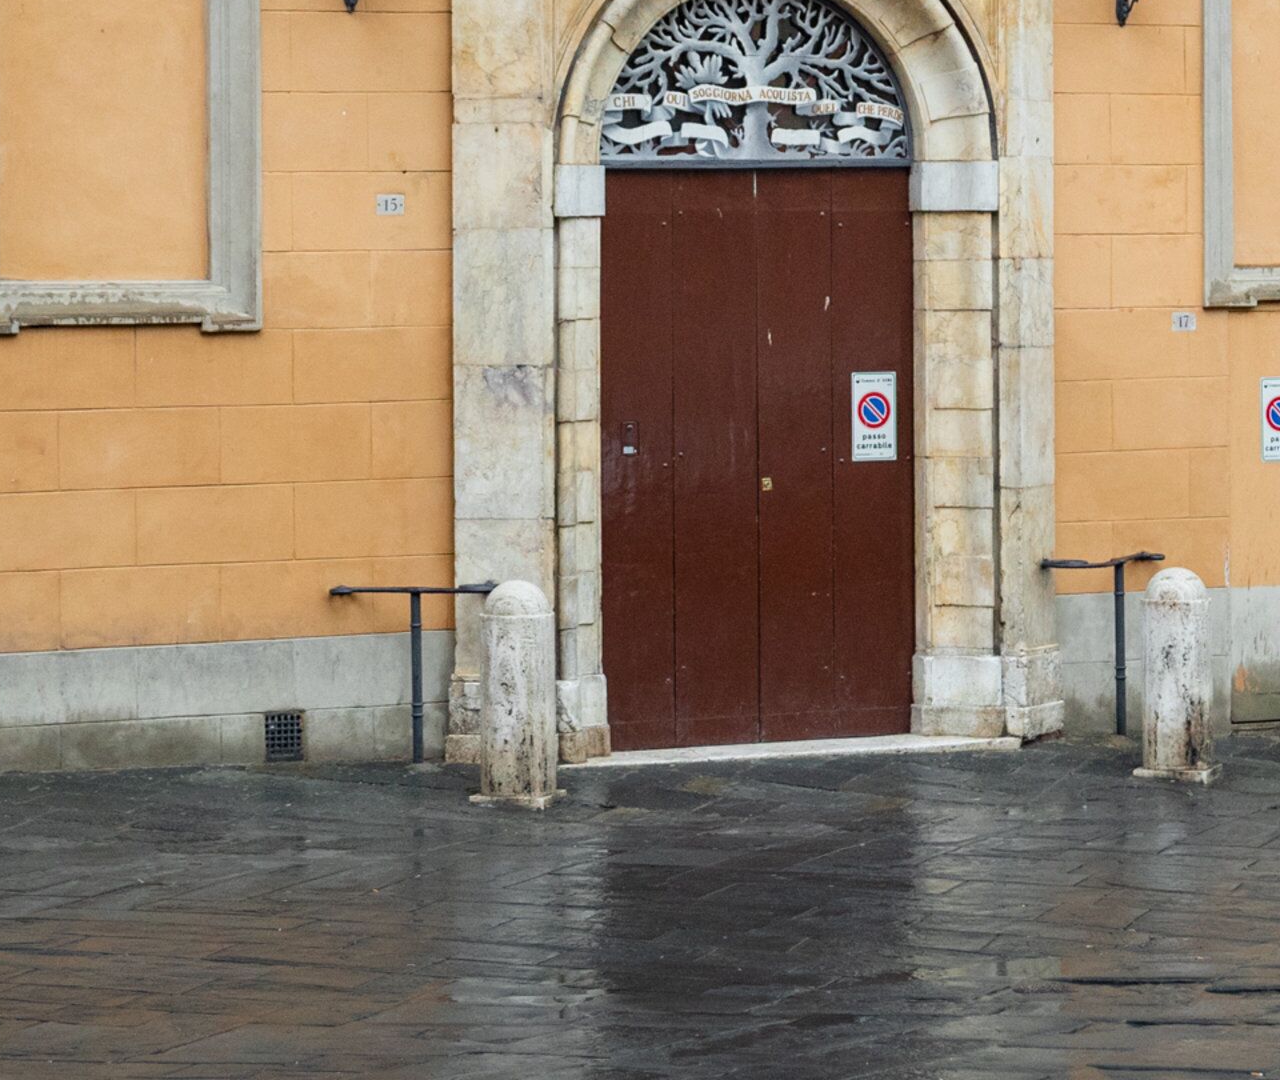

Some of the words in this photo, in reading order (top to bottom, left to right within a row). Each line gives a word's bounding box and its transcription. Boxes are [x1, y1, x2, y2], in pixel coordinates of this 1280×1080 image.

[613, 96, 636, 108] CHI
[692, 87, 753, 102] SOGGIORNA
[759, 89, 812, 102] ACQUISTA
[858, 104, 876, 115] CHE
[384, 198, 398, 211] 15
[1179, 315, 1190, 328] 17
[856, 441, 893, 450] carrabile
